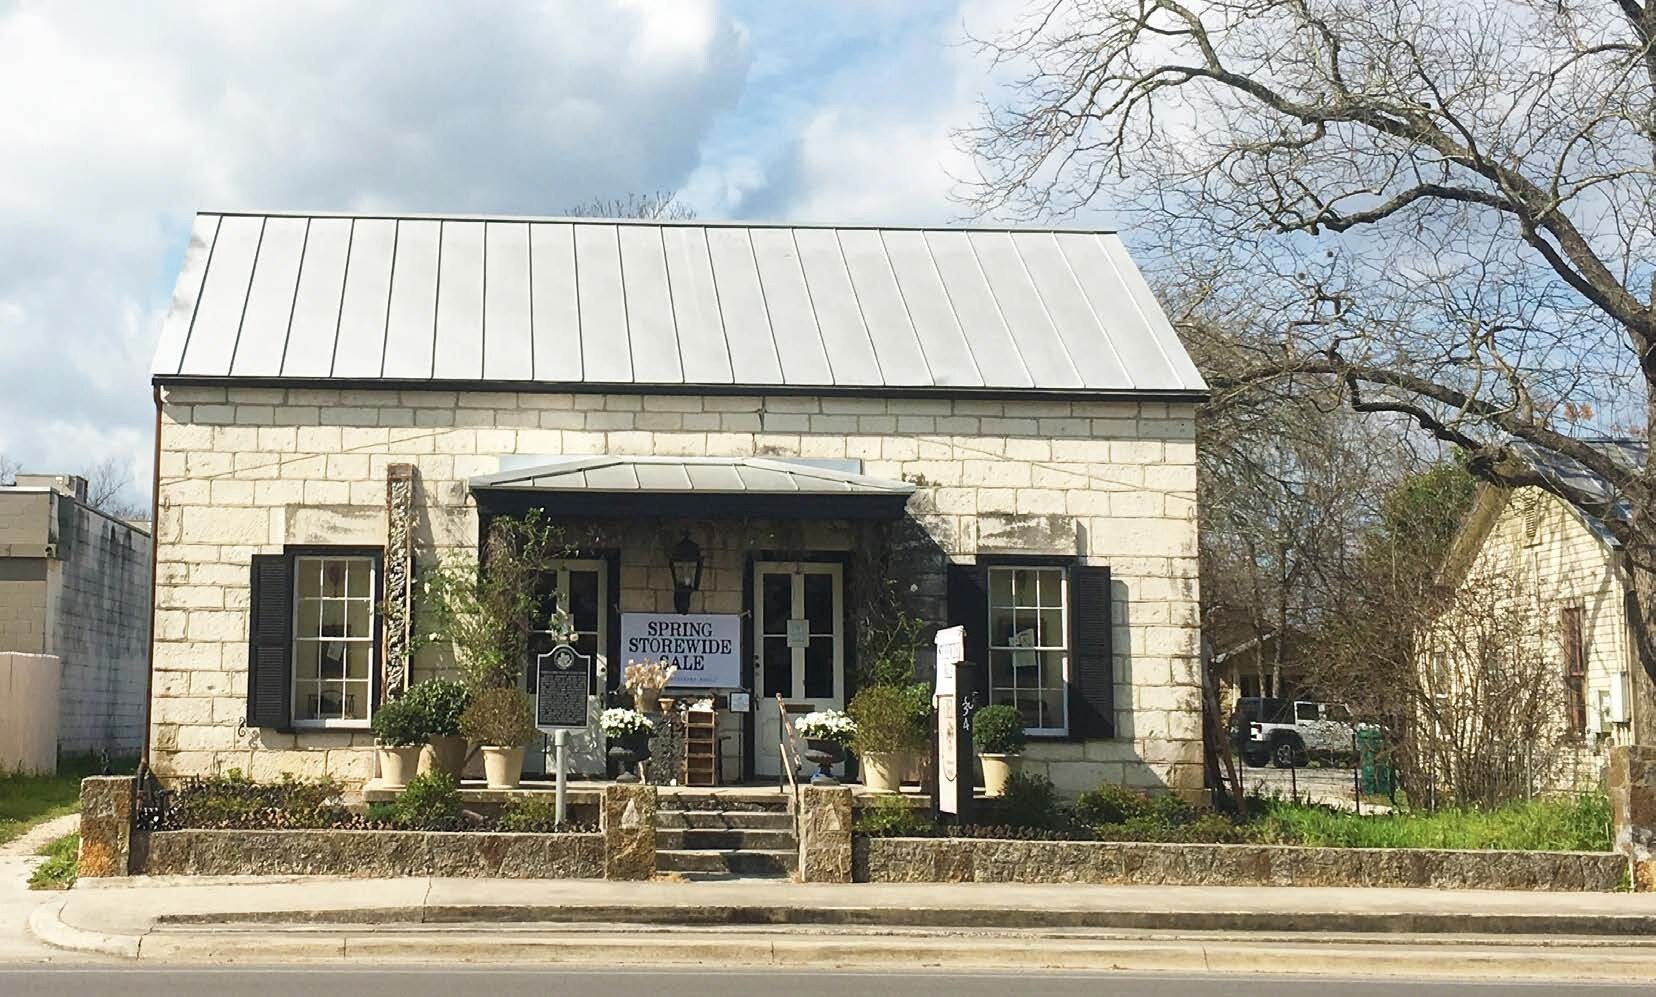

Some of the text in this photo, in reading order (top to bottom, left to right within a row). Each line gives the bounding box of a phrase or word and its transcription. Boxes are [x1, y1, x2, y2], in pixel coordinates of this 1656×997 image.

[648, 621, 712, 637] SPRING
[629, 638, 732, 655] STOREWIDE
[660, 655, 704, 671] SALE
